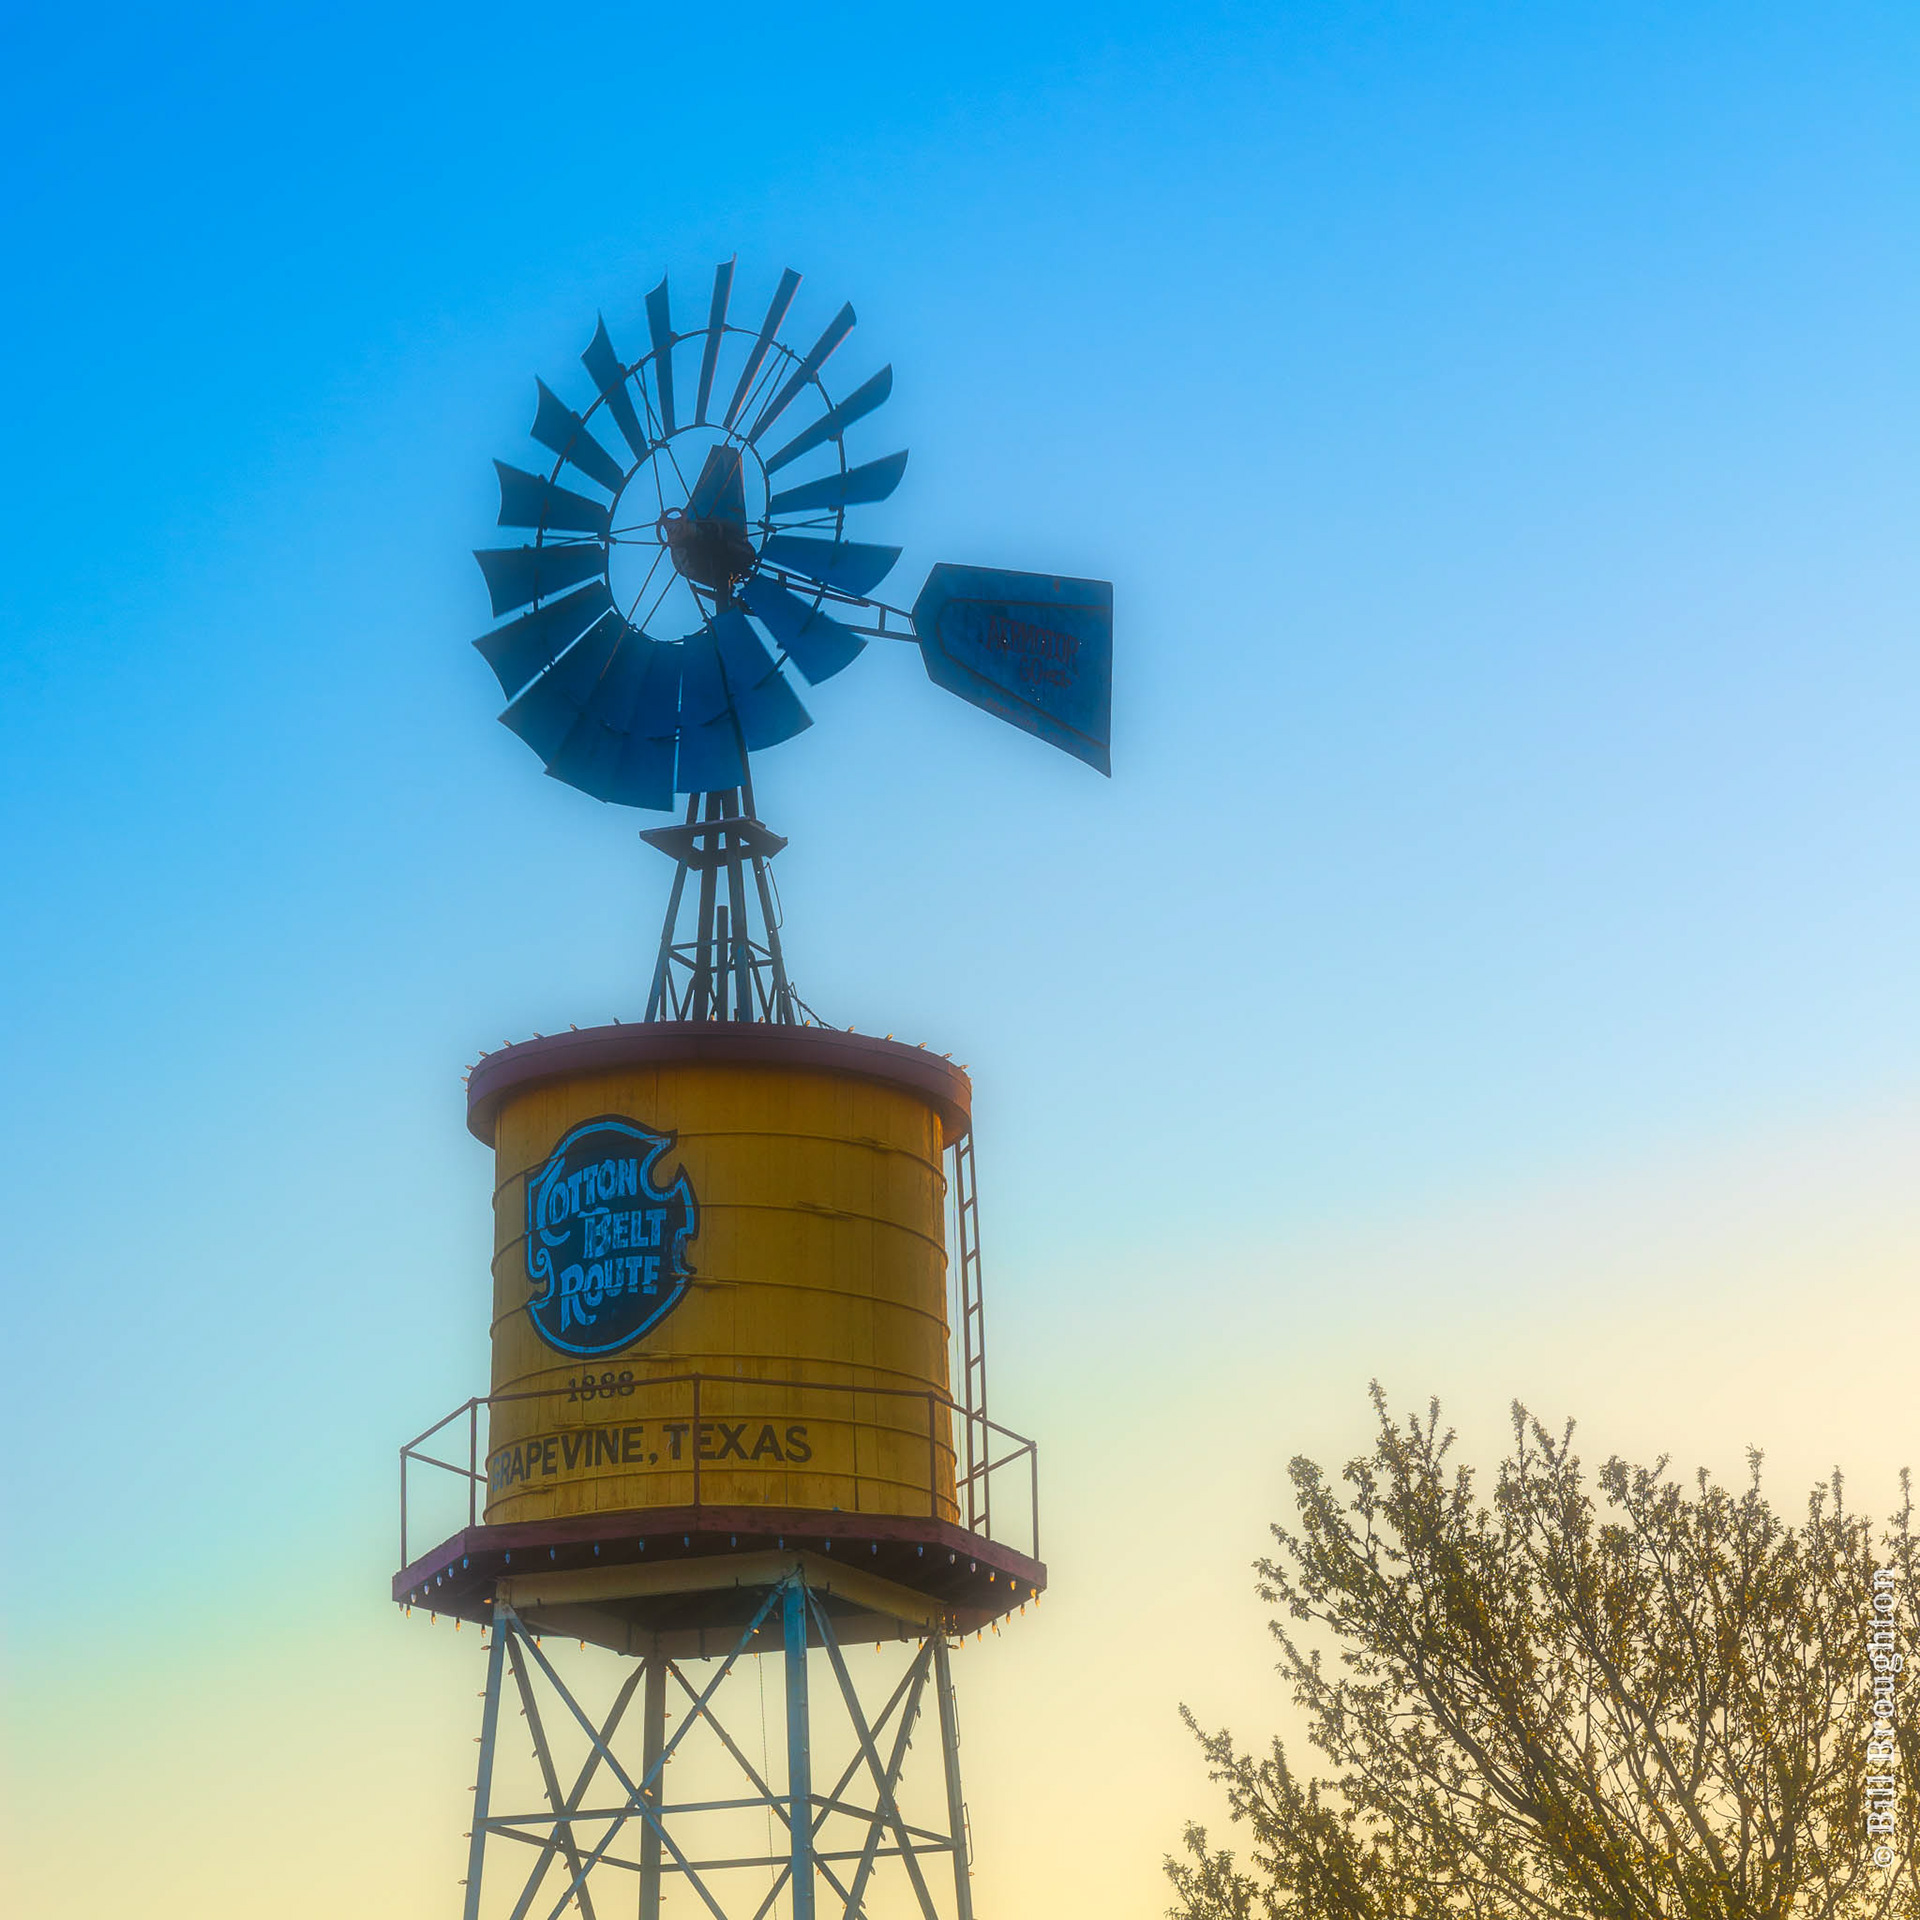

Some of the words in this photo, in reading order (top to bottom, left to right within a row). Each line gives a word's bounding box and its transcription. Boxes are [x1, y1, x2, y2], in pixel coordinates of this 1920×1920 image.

[536, 1157, 637, 1246] COTTON
[577, 1207, 667, 1259] BELT
[559, 1256, 661, 1333] ROUTE
[567, 1370, 636, 1402] 1888
[663, 1423, 812, 1463] TEXAS
